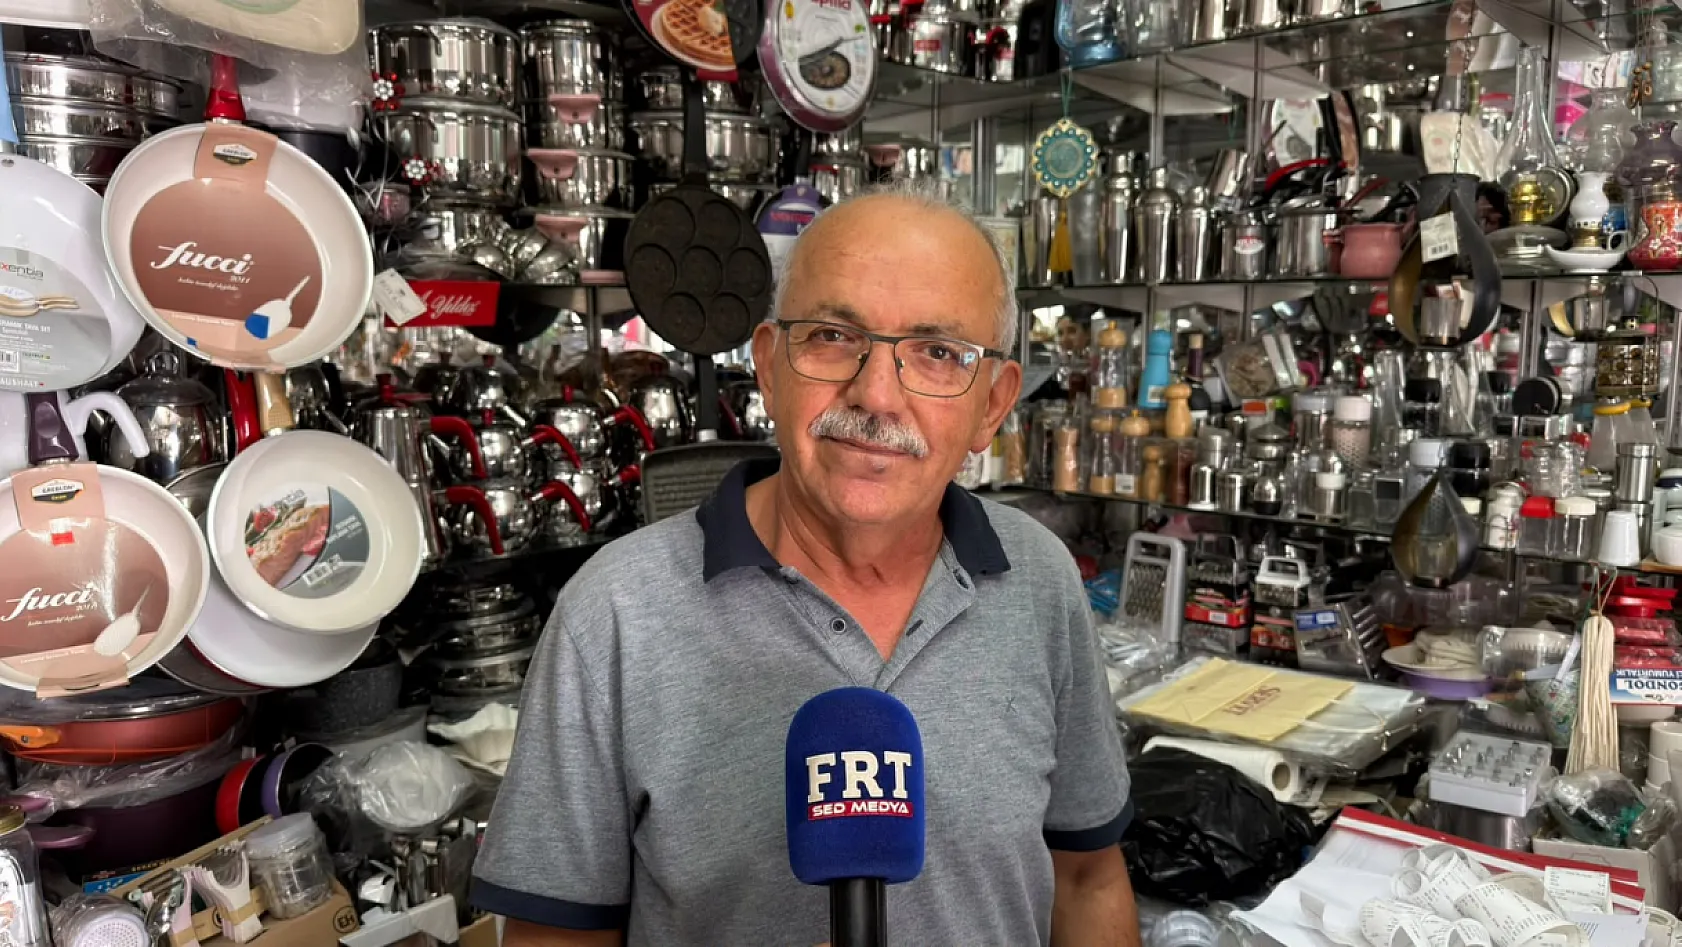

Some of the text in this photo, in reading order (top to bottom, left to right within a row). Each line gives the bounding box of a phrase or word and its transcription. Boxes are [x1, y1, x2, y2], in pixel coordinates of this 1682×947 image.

[150, 241, 251, 274] fucci
[0, 582, 93, 622] fucci
[805, 750, 912, 803] FRT
[812, 801, 909, 817] SED MEDYA
